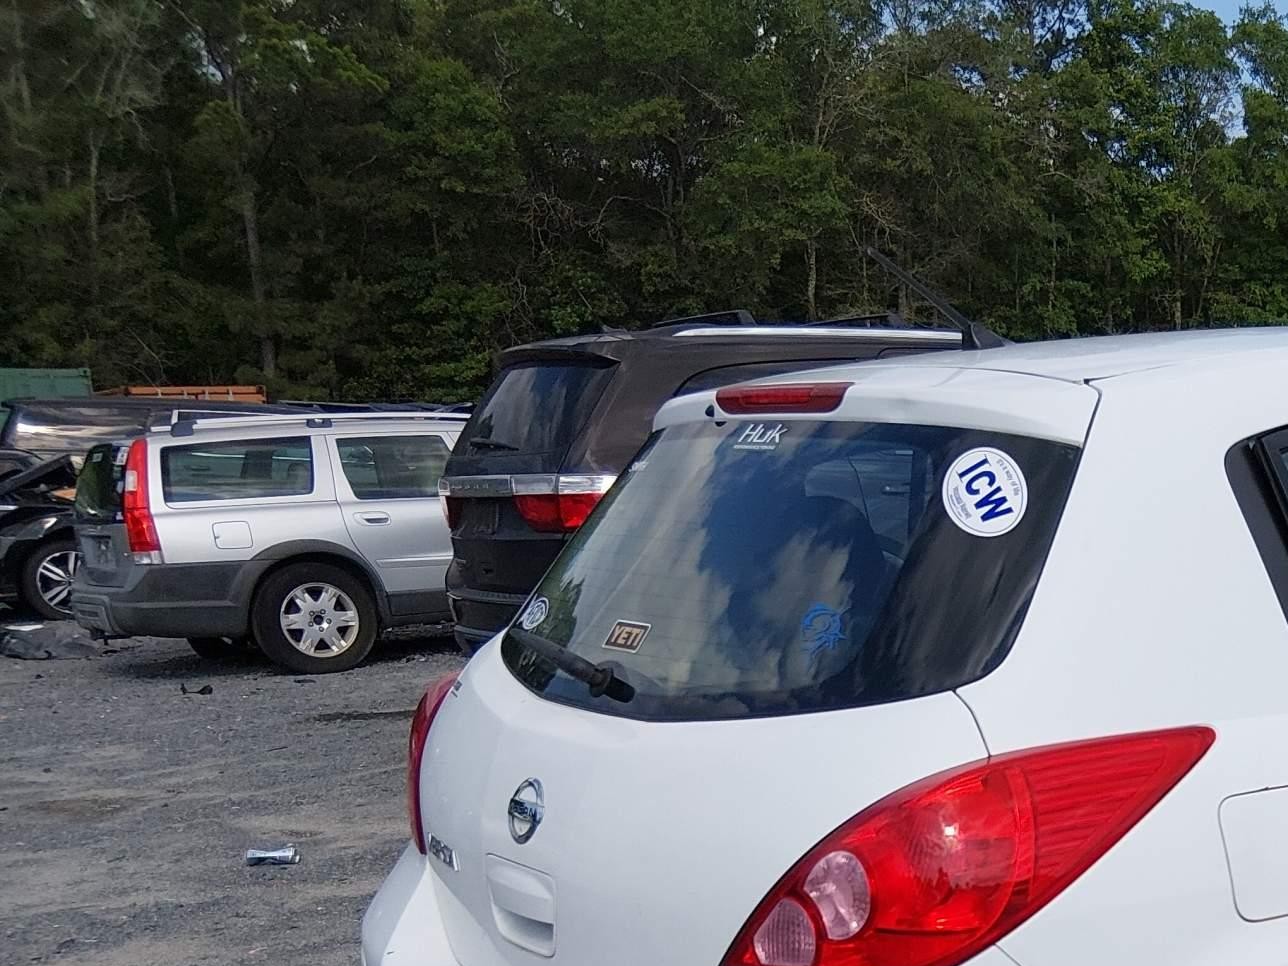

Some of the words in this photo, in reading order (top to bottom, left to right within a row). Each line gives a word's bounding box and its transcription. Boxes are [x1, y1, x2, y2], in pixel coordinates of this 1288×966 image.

[737, 423, 788, 443] Huk
[956, 454, 1014, 523] ICW
[610, 624, 645, 647] YETI
